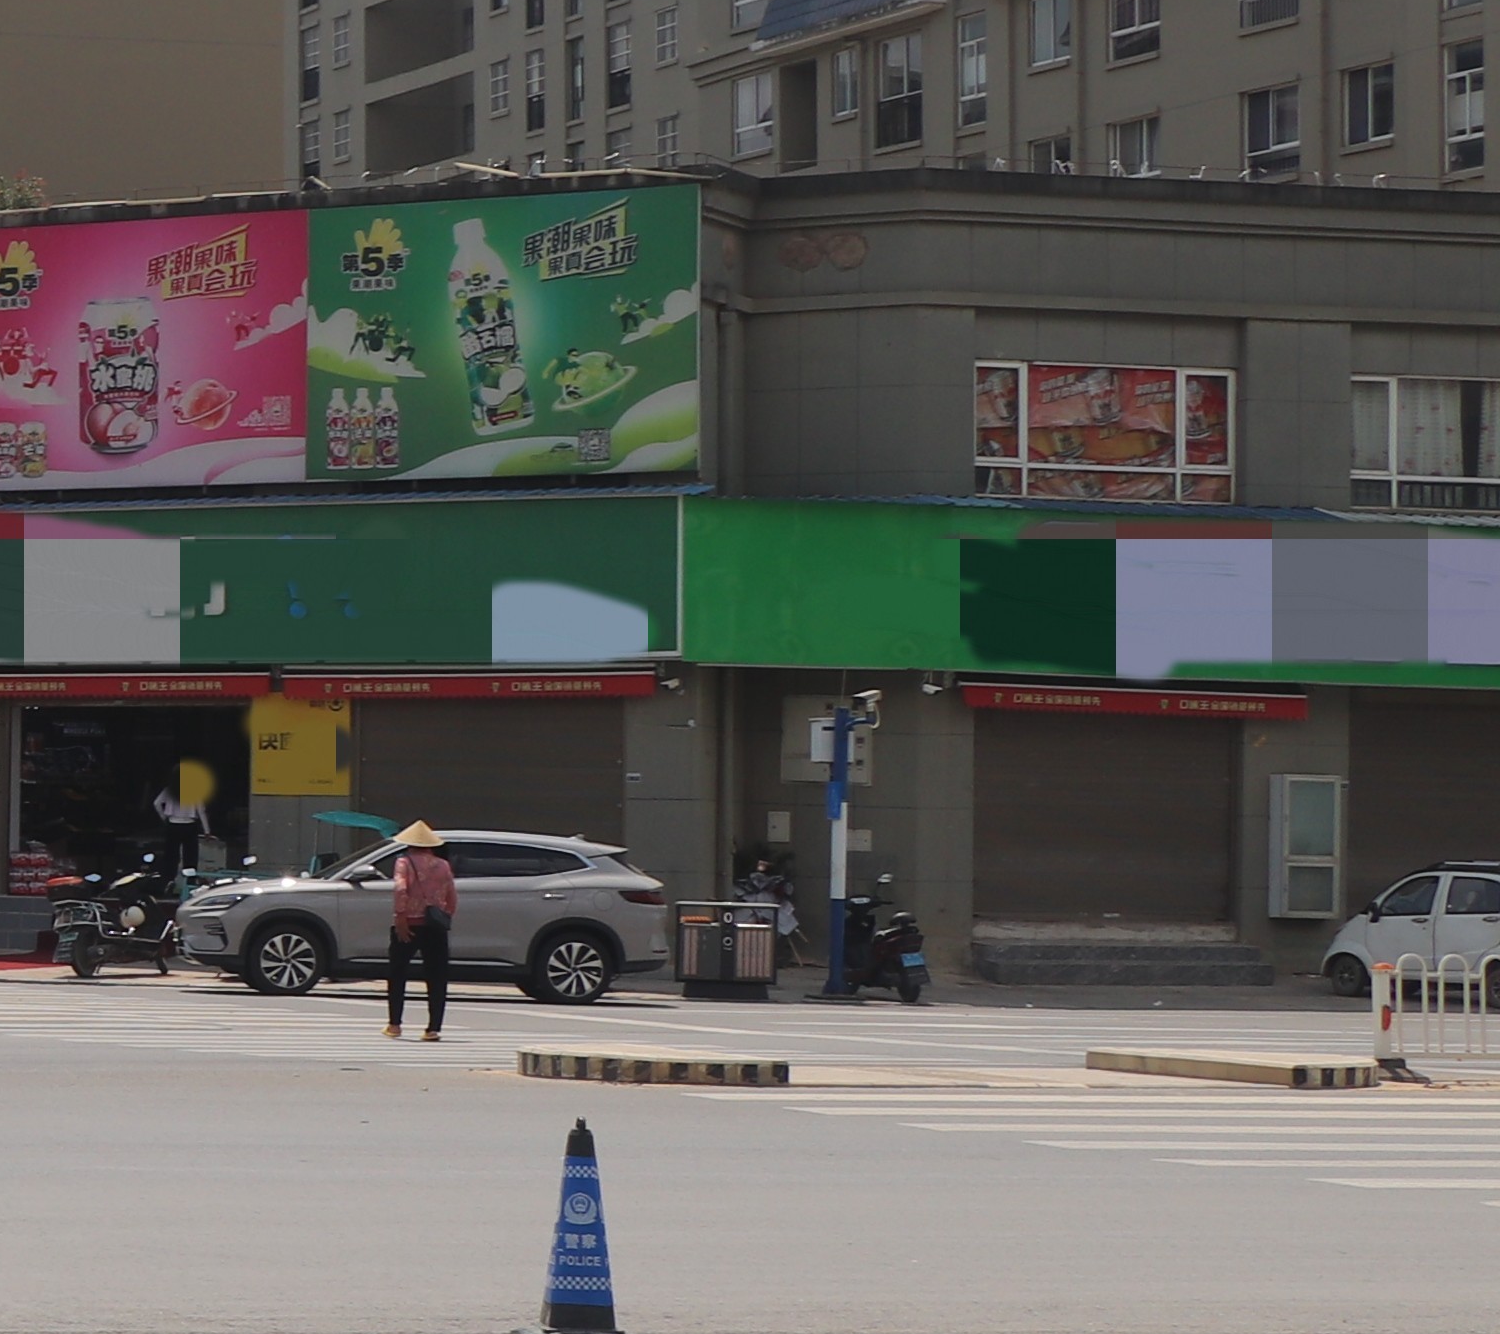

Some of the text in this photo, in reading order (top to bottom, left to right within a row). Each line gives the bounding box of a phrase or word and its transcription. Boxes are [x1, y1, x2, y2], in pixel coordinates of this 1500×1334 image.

[524, 215, 618, 264] 果潮果味
[547, 235, 638, 276] 果真会玩
[147, 240, 239, 284] 果潮果味
[169, 260, 257, 295] 果真会玩
[342, 247, 405, 277] 第5季
[91, 362, 157, 392] 水蜜桃
[564, 1233, 597, 1249] 警察
[559, 1255, 601, 1266] POLICE
